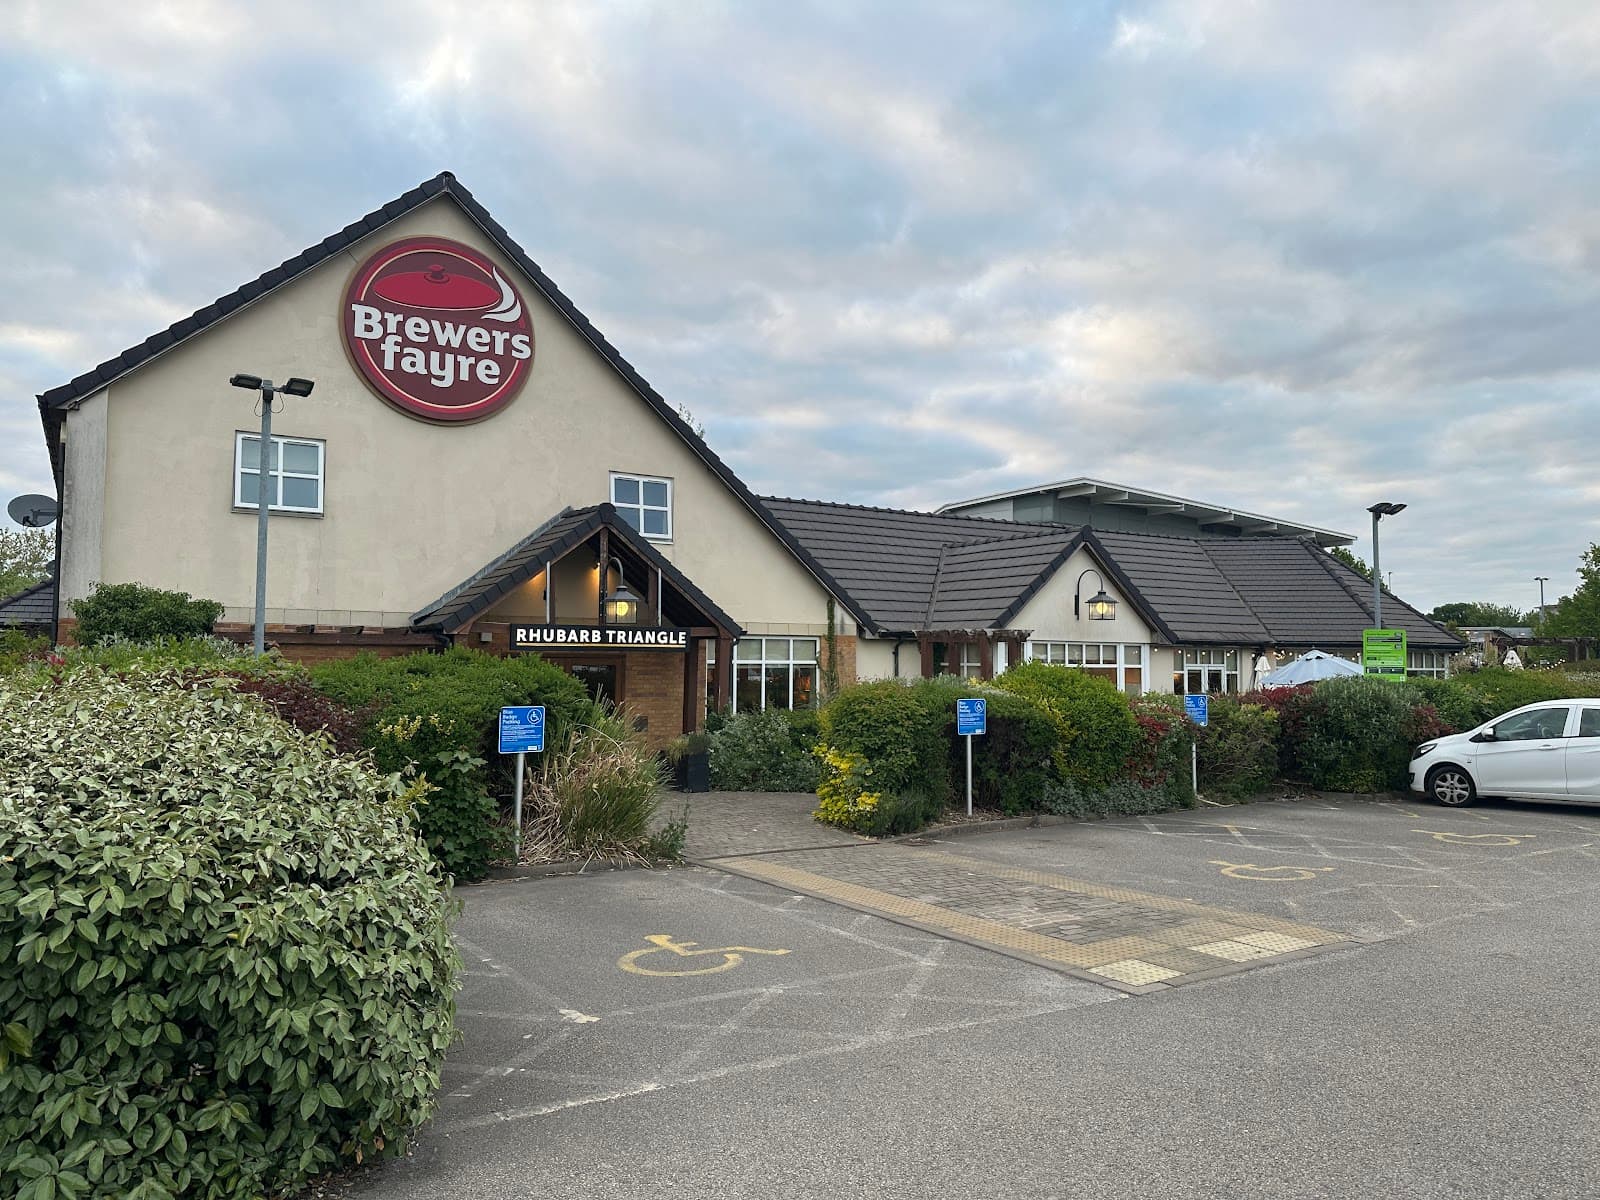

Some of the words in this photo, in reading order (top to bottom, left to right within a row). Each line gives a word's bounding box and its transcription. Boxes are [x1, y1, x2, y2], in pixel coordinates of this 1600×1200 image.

[351, 303, 532, 359] Brewers
[381, 335, 501, 388] fayre
[516, 628, 601, 643] RHUBARB
[606, 630, 687, 645] TRIANGLE
